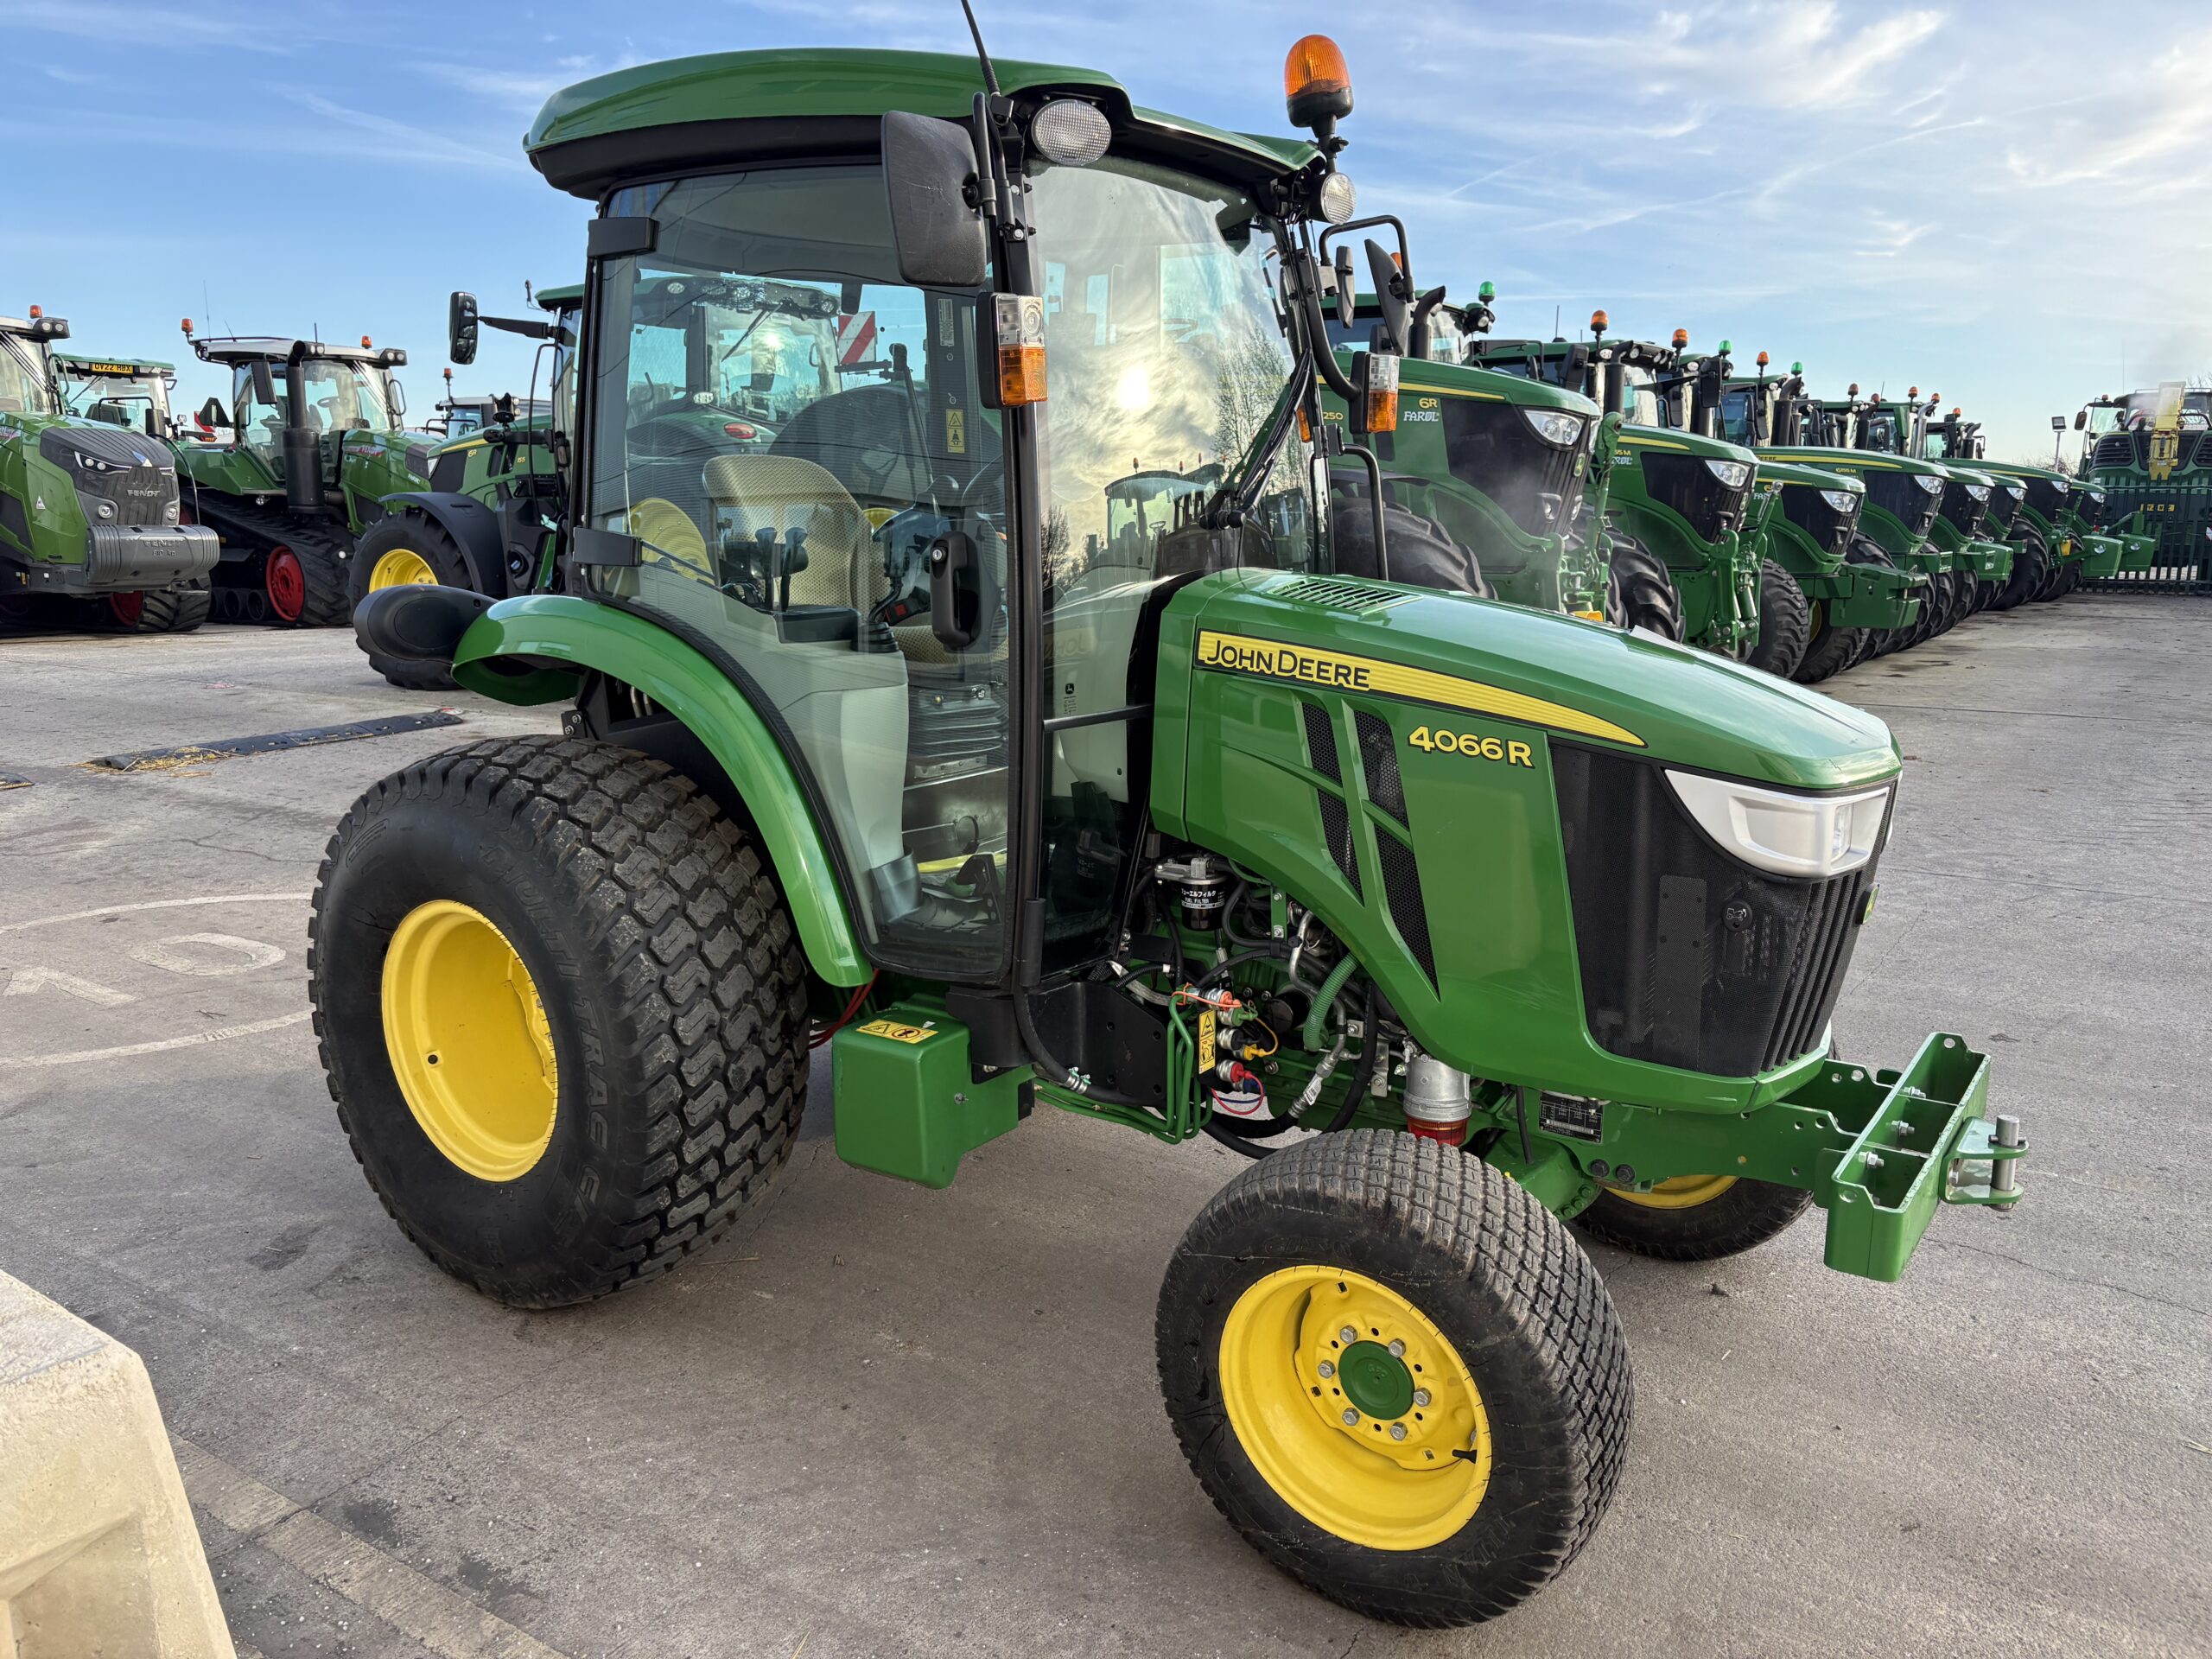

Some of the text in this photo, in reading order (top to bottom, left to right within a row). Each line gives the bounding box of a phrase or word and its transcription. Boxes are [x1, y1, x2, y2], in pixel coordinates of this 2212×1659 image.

[1419, 397, 1438, 409] 6R
[1207, 640, 1370, 688] JOHN DEERE
[573, 997, 610, 1152] TRAC
